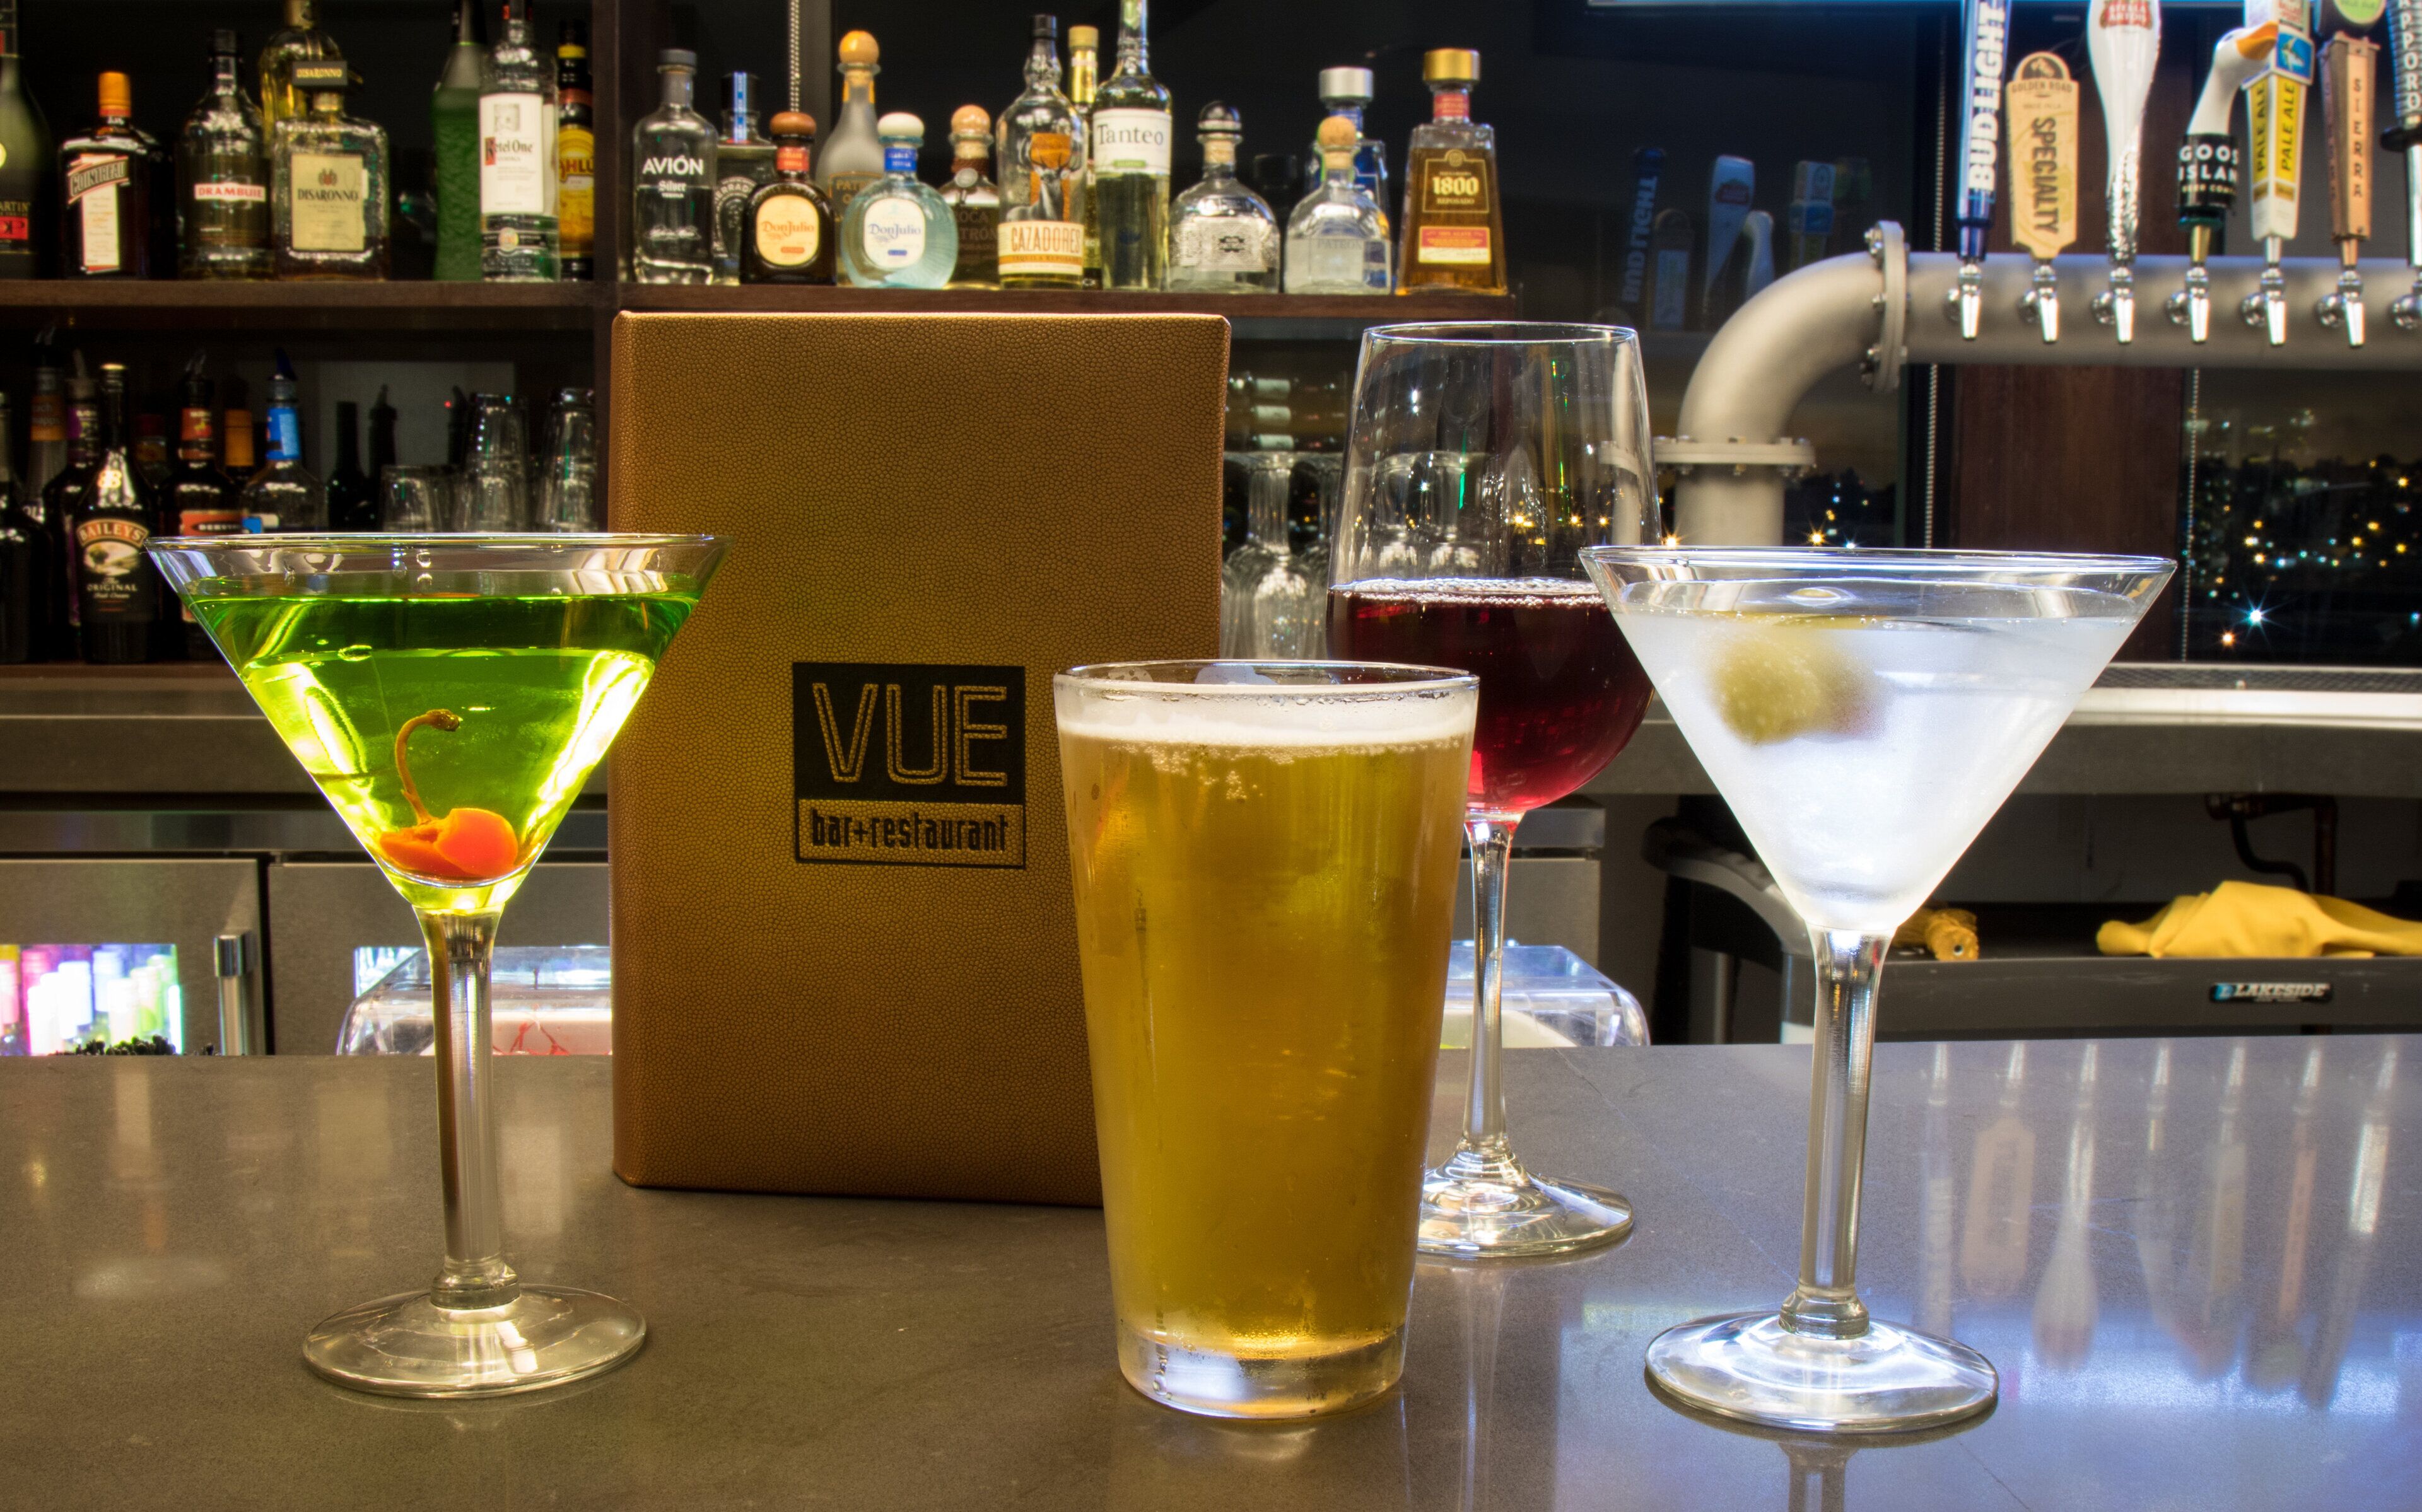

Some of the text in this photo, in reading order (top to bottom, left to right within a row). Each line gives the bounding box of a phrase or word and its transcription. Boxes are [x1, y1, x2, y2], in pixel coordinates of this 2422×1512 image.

[2398, 0, 2421, 110] APPORO
[296, 68, 342, 78] DISARONNO
[1968, 1, 2006, 192] BUD LIGHT
[2012, 81, 2073, 93] GOLDEN ROAD
[1097, 124, 1164, 146] Tanteo
[2281, 83, 2295, 171] PALE ALE
[2353, 78, 2363, 197] SIERRA
[512, 139, 533, 153] One
[642, 154, 704, 176] AVIÓN
[2032, 117, 2059, 234] SPECIALTY
[2178, 165, 2238, 183] ISLAN
[71, 160, 126, 197] COINTREAU
[1432, 177, 1480, 196] 1800
[199, 187, 263, 198] DRAMBUIE
[297, 189, 358, 201] DISARONNO
[1011, 226, 1080, 253] CAZADORES
[79, 522, 141, 541] BAILEYS
[87, 583, 137, 591] ORIGINAL
[812, 682, 1008, 787] VUE
[811, 807, 1009, 852] bar+restaurant
[2233, 982, 2331, 997] LAKESIDE
